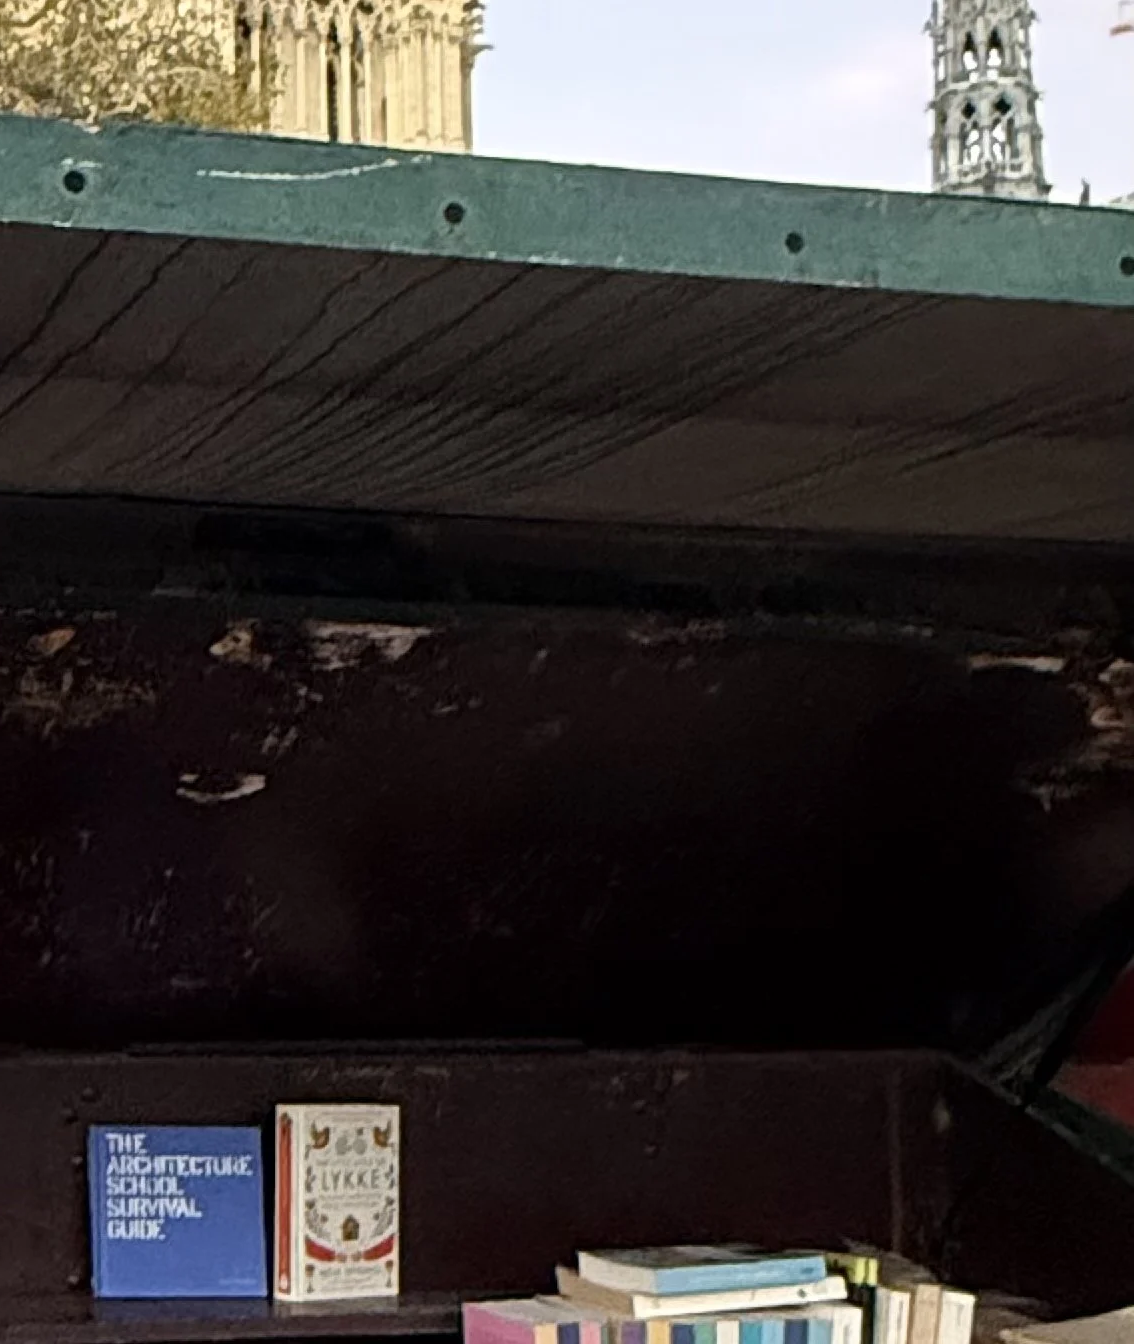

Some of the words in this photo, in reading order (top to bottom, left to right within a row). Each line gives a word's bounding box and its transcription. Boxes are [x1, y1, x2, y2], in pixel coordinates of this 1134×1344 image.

[105, 1132, 147, 1154] THE
[106, 1154, 253, 1176] ARCHITECTURE
[106, 1176, 184, 1196] SCHOOL
[321, 1168, 382, 1191] LYKKE
[106, 1197, 203, 1218] SURVIVAL
[107, 1218, 166, 1240] GUIDE
